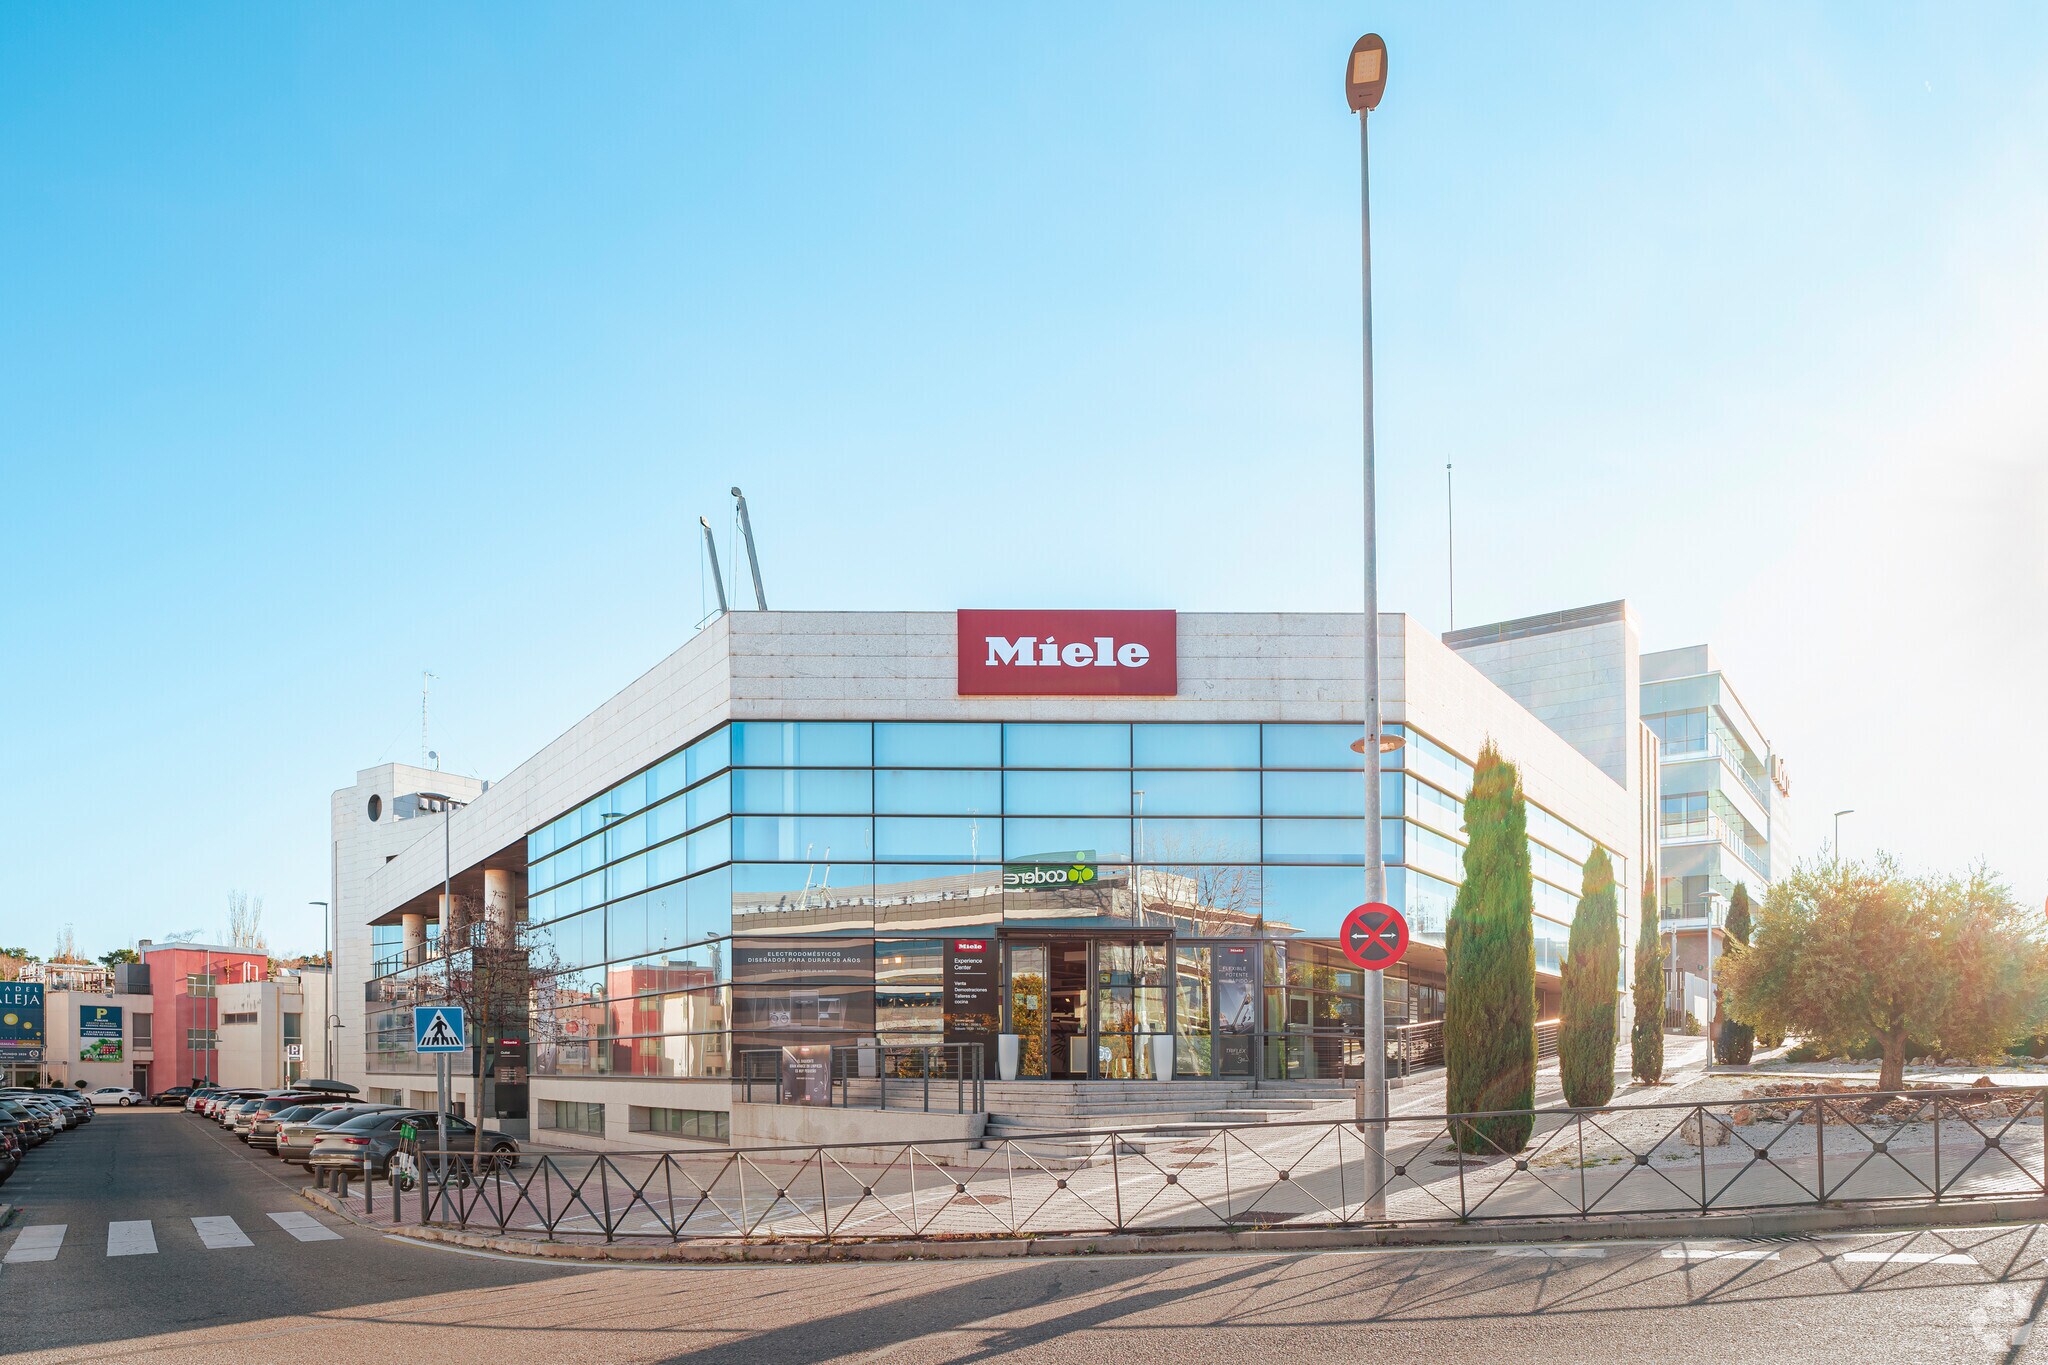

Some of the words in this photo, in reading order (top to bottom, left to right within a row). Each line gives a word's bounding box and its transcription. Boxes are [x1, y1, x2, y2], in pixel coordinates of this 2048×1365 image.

[985, 635, 1150, 668] Miele
[954, 957, 983, 965] Experience
[96, 1008, 108, 1019] P
